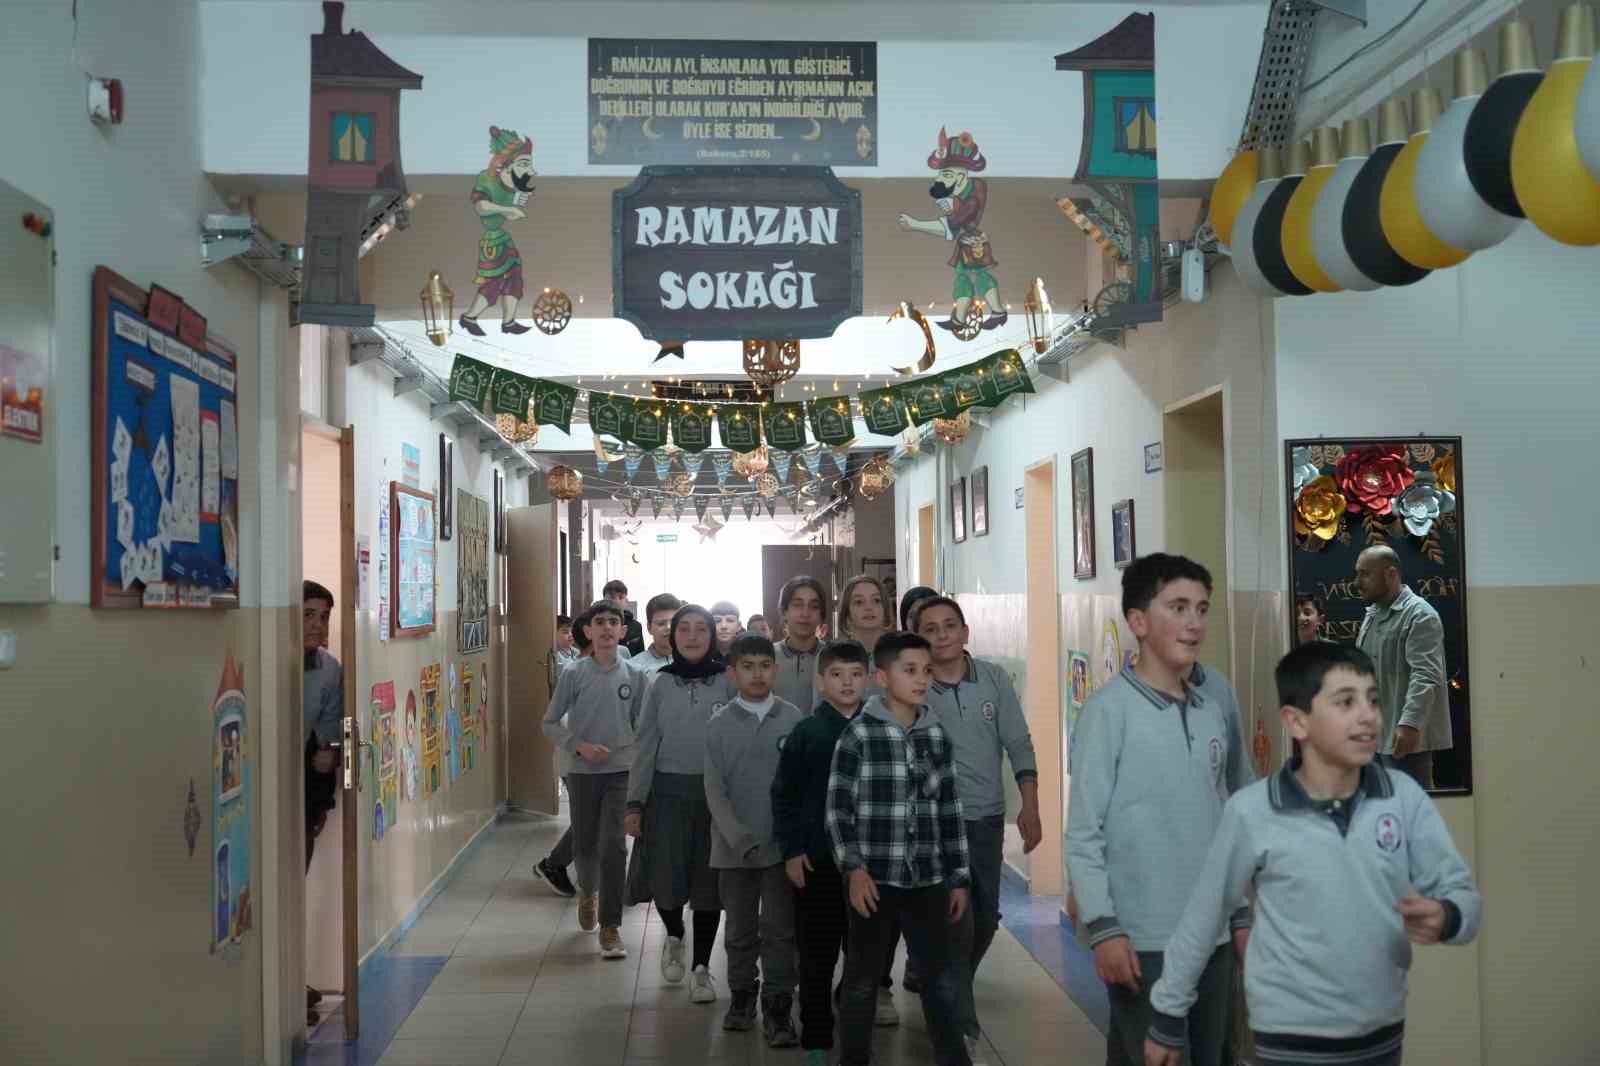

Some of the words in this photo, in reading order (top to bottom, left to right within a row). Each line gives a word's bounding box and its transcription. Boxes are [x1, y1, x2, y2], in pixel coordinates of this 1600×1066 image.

[611, 57, 671, 73] RAMAZAN
[701, 54, 766, 74] İNSANLARA
[770, 58, 792, 75] YOL
[655, 79, 671, 95] VE
[655, 100, 701, 117] OLARAK
[635, 206, 839, 247] RAMAZAN
[659, 260, 818, 310] SOKAĞI
